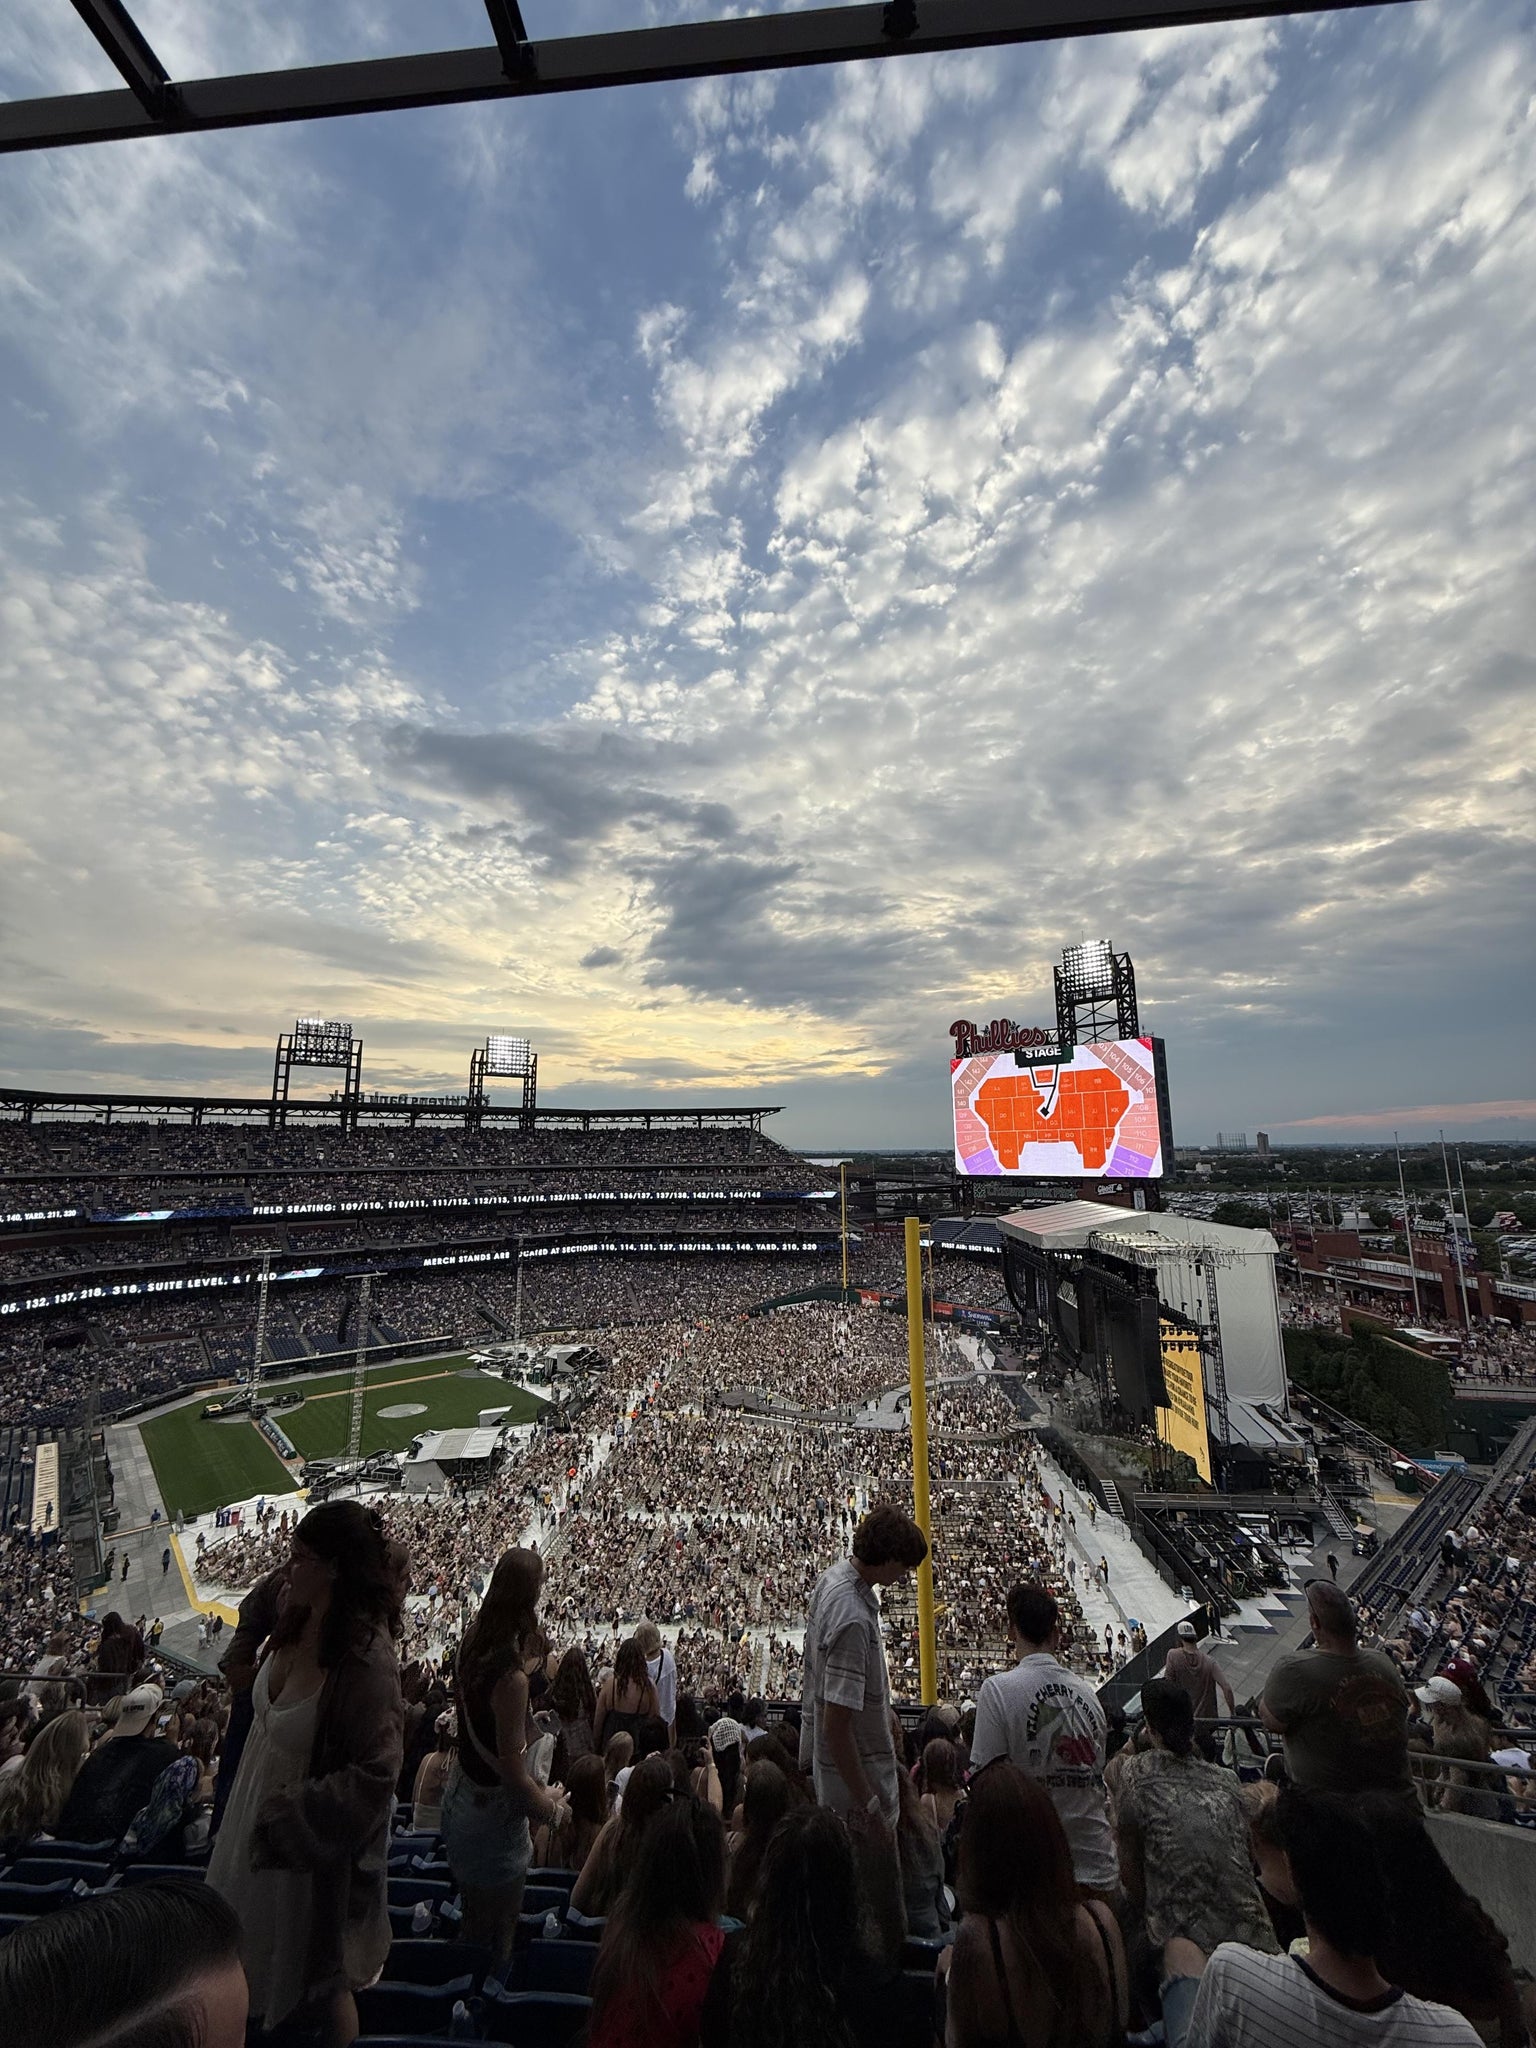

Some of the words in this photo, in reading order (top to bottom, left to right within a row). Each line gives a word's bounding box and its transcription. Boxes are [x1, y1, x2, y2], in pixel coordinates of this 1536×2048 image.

[949, 1018, 1046, 1056] Phillies
[1025, 1046, 1062, 1059] STAGE
[1109, 1052, 1120, 1062] 104
[1122, 1062, 1133, 1074] 105
[1134, 1073, 1145, 1084] 106
[253, 1206, 282, 1215] FIELD
[287, 1204, 336, 1213] SEATING:
[341, 1202, 384, 1210] 109/110,
[388, 1200, 429, 1209] 110/111,
[433, 1198, 470, 1206] 111/112,
[474, 1196, 510, 1204] 112/113,
[24, 1212, 46, 1220] YARD,
[424, 1256, 456, 1266] MERCH
[458, 1253, 491, 1263] STANDS
[494, 1252, 510, 1260] ARE
[562, 1244, 598, 1254] SECTIONS
[25, 1297, 49, 1310] 132,
[54, 1292, 77, 1304] 137,
[80, 1288, 106, 1299] 218,
[112, 1284, 141, 1295] 318,
[147, 1280, 182, 1292] SUITE
[187, 1277, 228, 1288] LEVEL,
[1035, 1684, 1073, 1704] CHERRY
